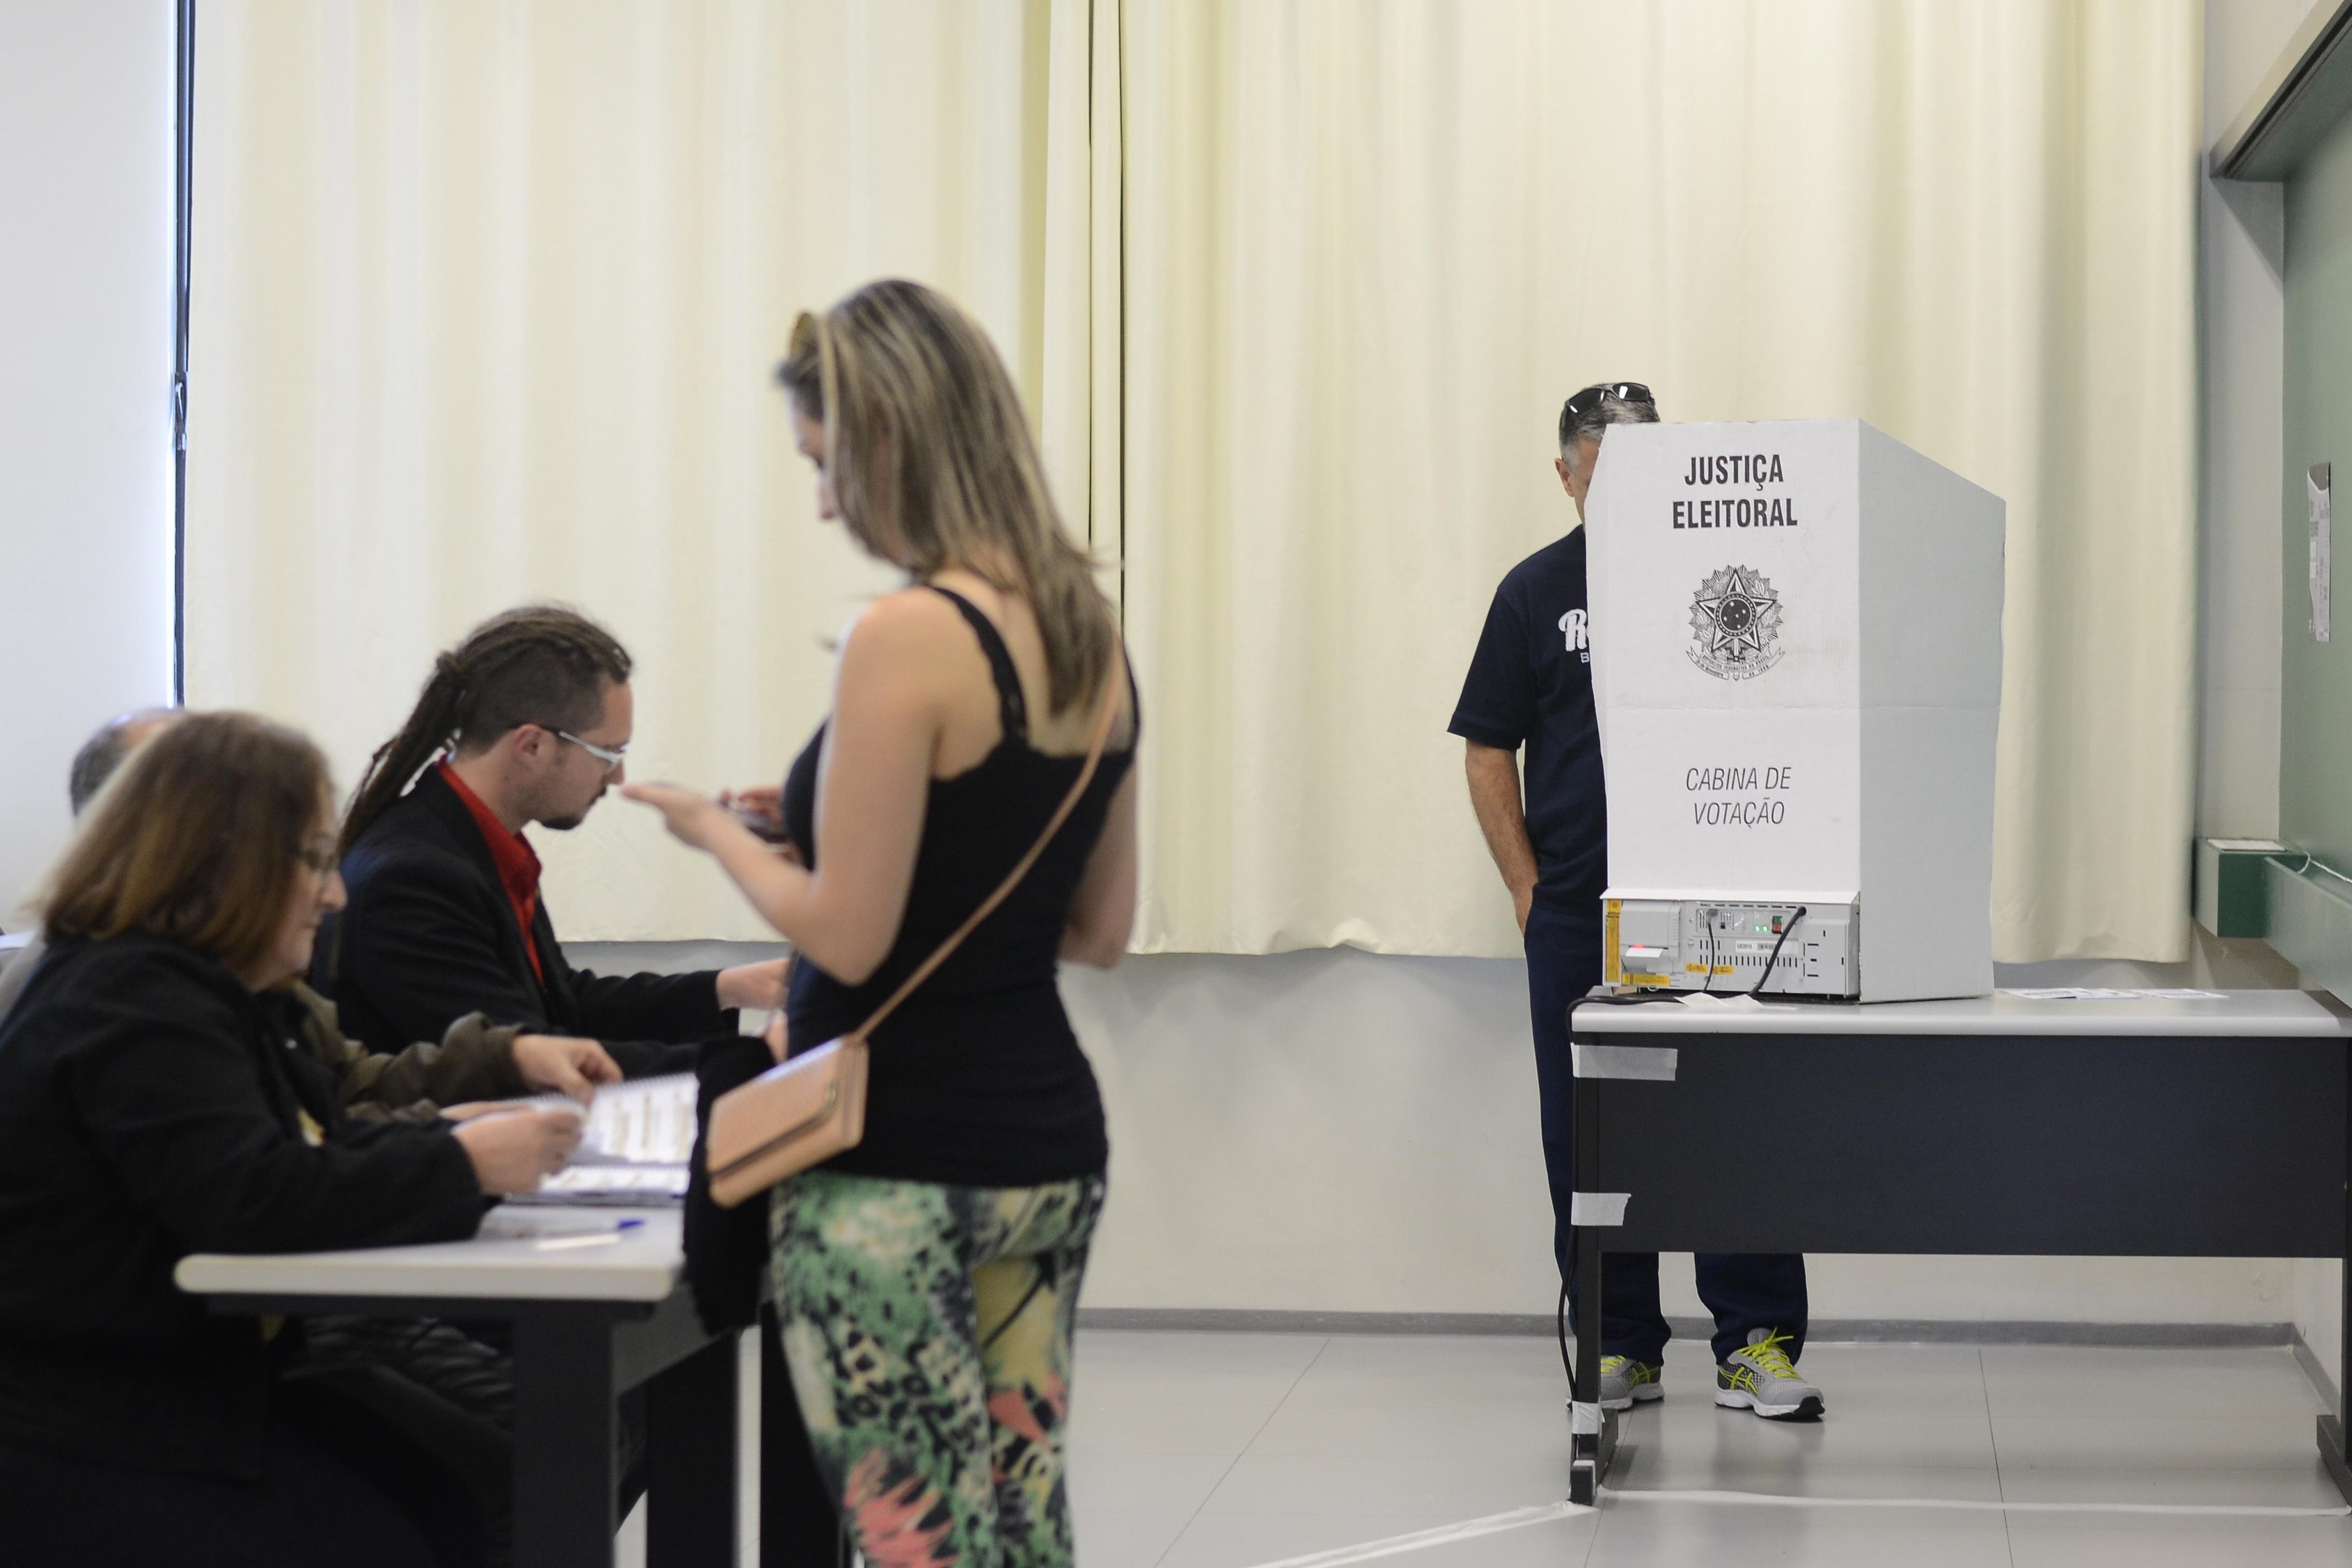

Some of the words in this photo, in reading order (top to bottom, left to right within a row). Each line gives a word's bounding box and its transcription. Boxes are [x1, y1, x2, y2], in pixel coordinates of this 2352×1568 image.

[1684, 454, 1784, 491] JUSTIÇA
[1672, 498, 1798, 529] ELEITORAL
[1558, 608, 1588, 652] R
[1686, 767, 1757, 791] CABINA
[1765, 767, 1792, 790] DE
[1694, 797, 1785, 828] VOTAÇÃO
